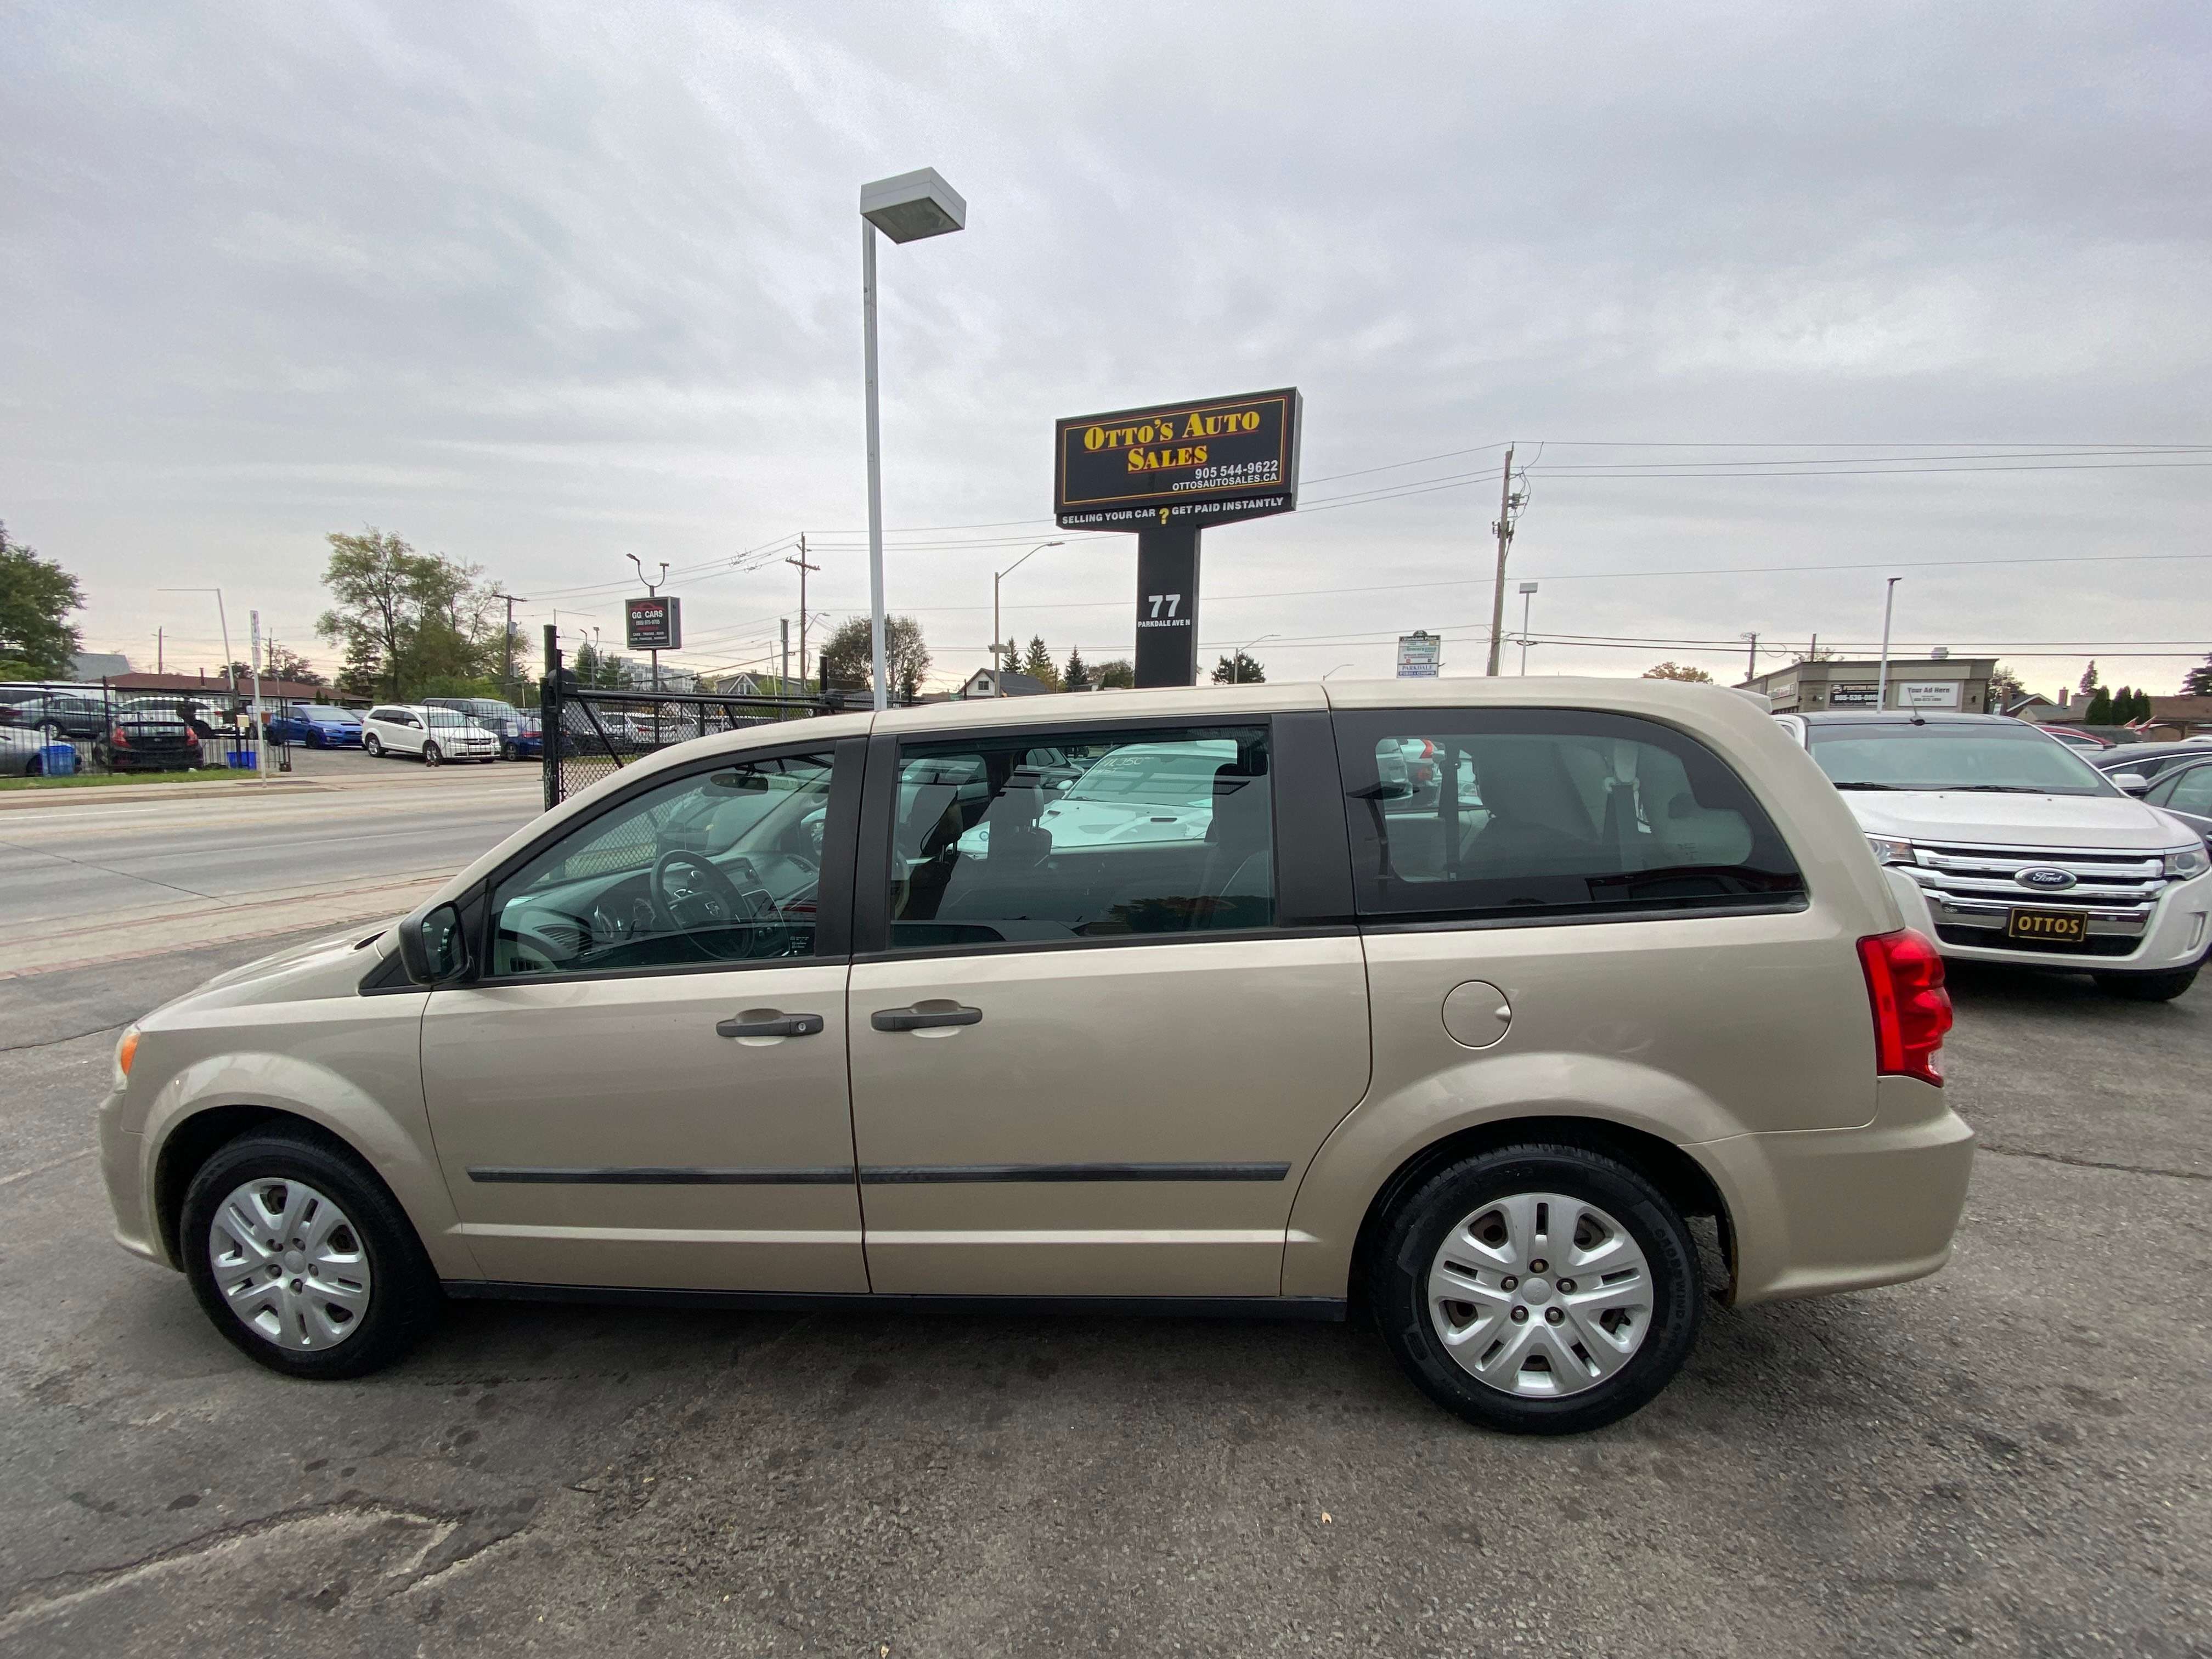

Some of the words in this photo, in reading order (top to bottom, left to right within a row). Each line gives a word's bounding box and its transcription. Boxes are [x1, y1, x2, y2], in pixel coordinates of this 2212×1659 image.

[1084, 418, 1173, 450] OTTO'S
[1182, 411, 1260, 438] AUTO
[1127, 445, 1209, 472] SALES
[1195, 467, 1217, 479] 905
[1220, 460, 1278, 476] 544-9622
[1172, 473, 1277, 491] OTTOSAUTOSALES.CA
[1062, 513, 1103, 524] SELLING
[1105, 511, 1132, 521] YOUR
[1135, 509, 1155, 518] CAR
[1171, 505, 1193, 515] GET
[1194, 503, 1219, 512] PAID
[1222, 498, 1283, 511] INSTANTLY
[1148, 594, 1181, 618] 77
[2032, 872, 2062, 882] Ford
[2018, 916, 2079, 934] OTTOS
